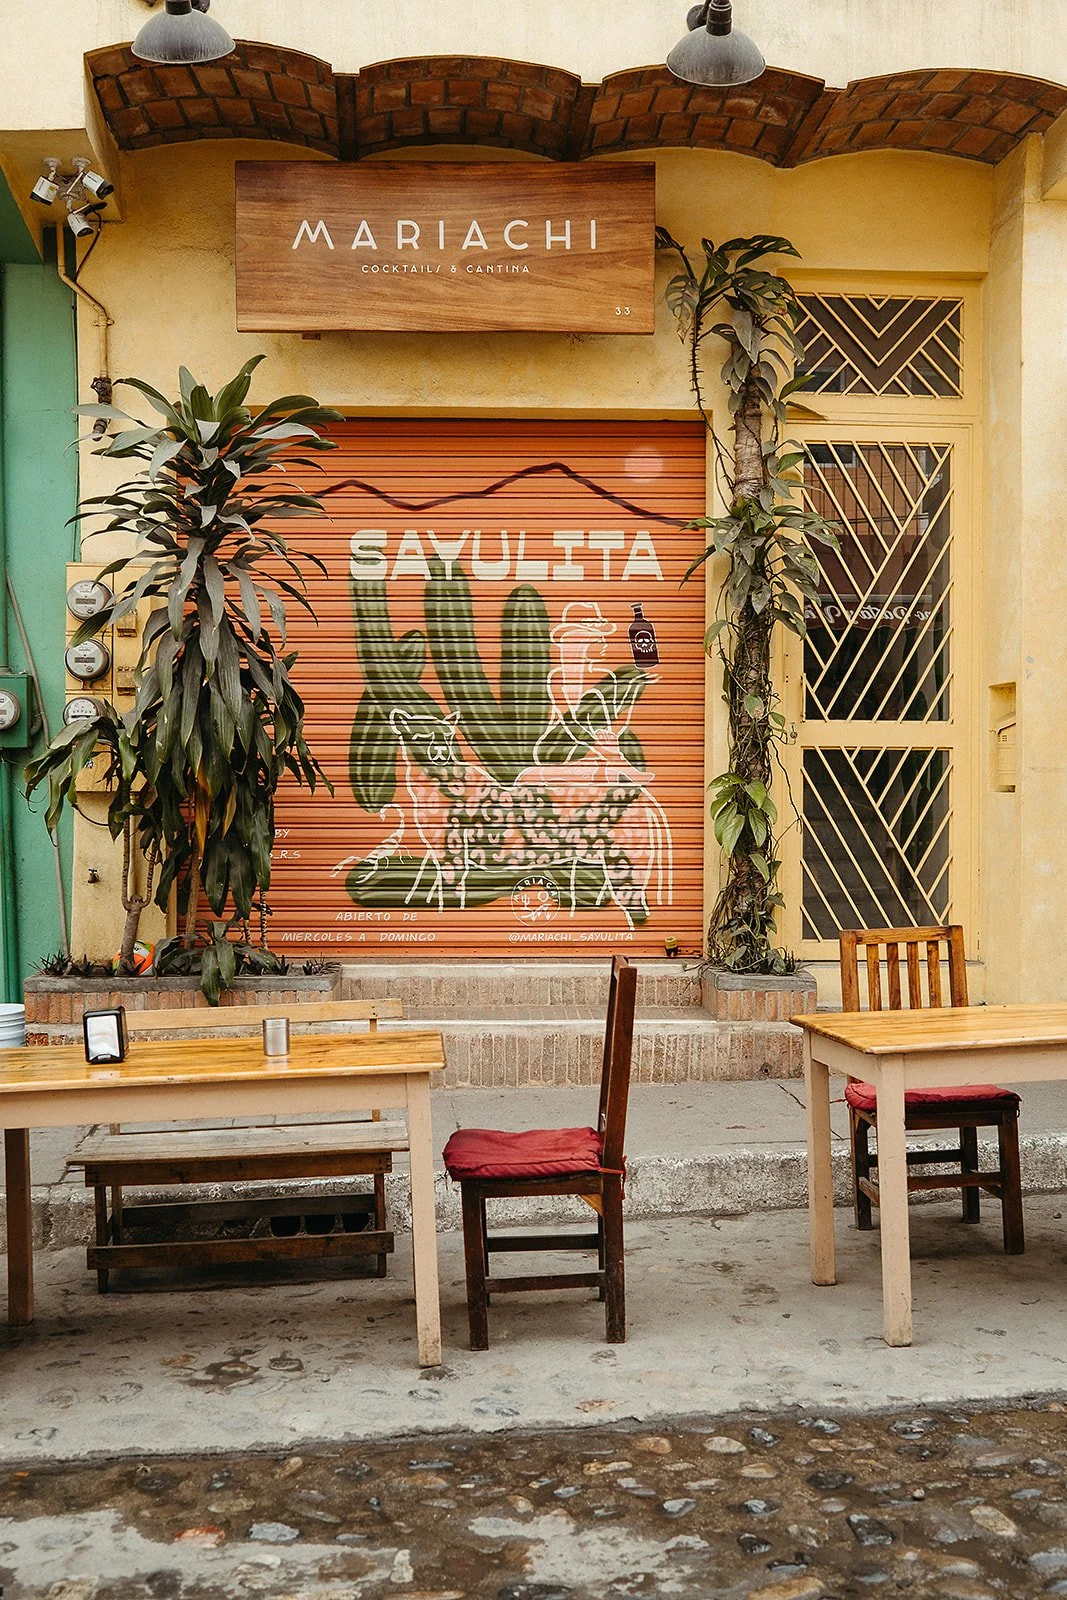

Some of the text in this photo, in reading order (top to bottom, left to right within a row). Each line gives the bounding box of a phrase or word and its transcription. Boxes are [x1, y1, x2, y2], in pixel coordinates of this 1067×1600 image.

[292, 219, 597, 250] MARIACHI
[361, 264, 530, 274] COCKTAILS & CANTINA
[614, 306, 631, 316] 33
[349, 529, 664, 581] SAYULITA
[274, 828, 291, 839] BY
[513, 877, 559, 903] MARIACHI
[335, 911, 418, 921] ABIERTO DE
[281, 932, 436, 942] MIERCOLES A DOMINGO
[508, 932, 633, 943] @MARIACHI_SAYULITA
